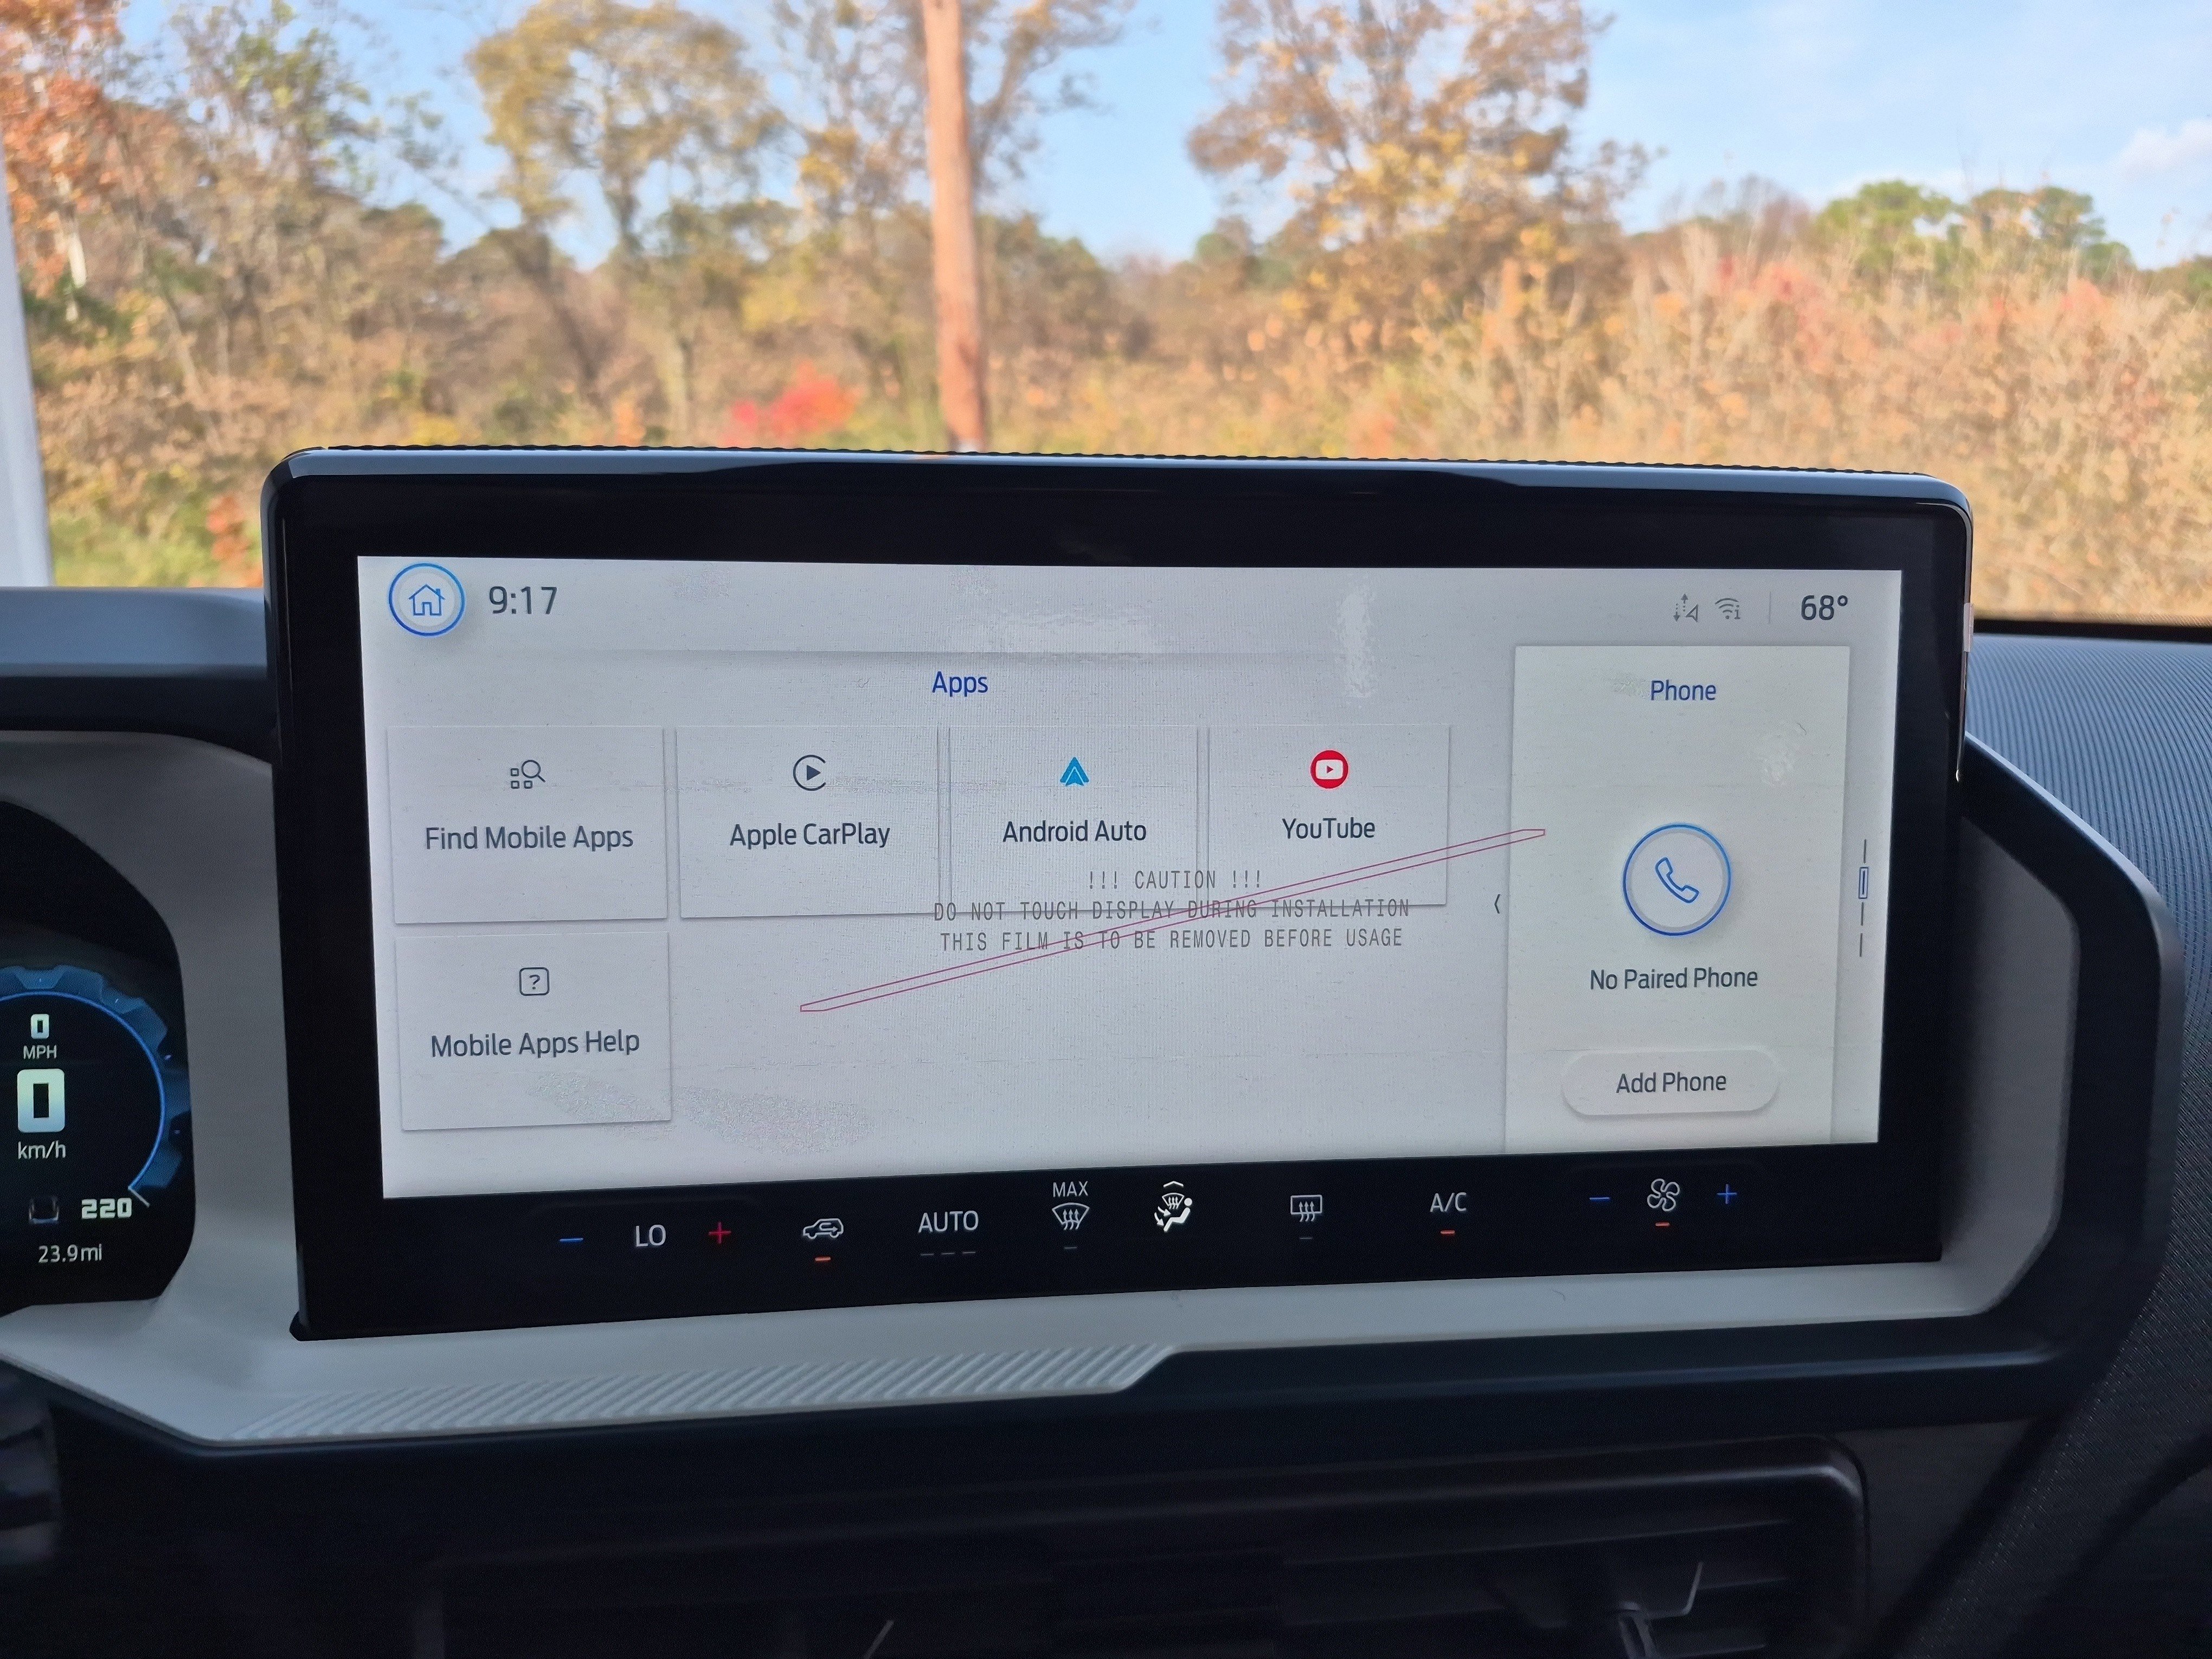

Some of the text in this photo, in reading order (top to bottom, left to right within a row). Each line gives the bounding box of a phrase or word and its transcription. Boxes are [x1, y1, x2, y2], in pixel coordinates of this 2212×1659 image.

[489, 586, 558, 615] 9:17
[932, 671, 988, 698] Apps
[1650, 680, 1717, 701] Phone
[426, 825, 634, 852] Find Mobile Apps
[730, 822, 891, 850] Apple CarPlay
[1002, 820, 1147, 843] Android Auto
[1282, 818, 1375, 840] YouTube
[1089, 870, 1261, 889] !!! CAUTION !!!
[934, 898, 1409, 921] DO NOT TOUCH DISPLAY DURING INSTALLATION
[941, 928, 1402, 951] THIS FILM IS TO BE REMOVED BEFORE USAGE
[1590, 967, 1758, 990] No Paired Phone
[30, 1013, 49, 1039] 0
[23, 1045, 57, 1059] MPH
[431, 1029, 640, 1058] Mobile Apps Help
[1616, 1071, 1727, 1094] Add Phone
[17, 1068, 65, 1133] 0
[18, 1141, 66, 1159] km/h
[1052, 1181, 1089, 1198] MAX
[81, 1197, 132, 1219] 220
[1430, 1192, 1467, 1213] A/C
[918, 1210, 979, 1233] AUTO
[635, 1224, 666, 1248] LO
